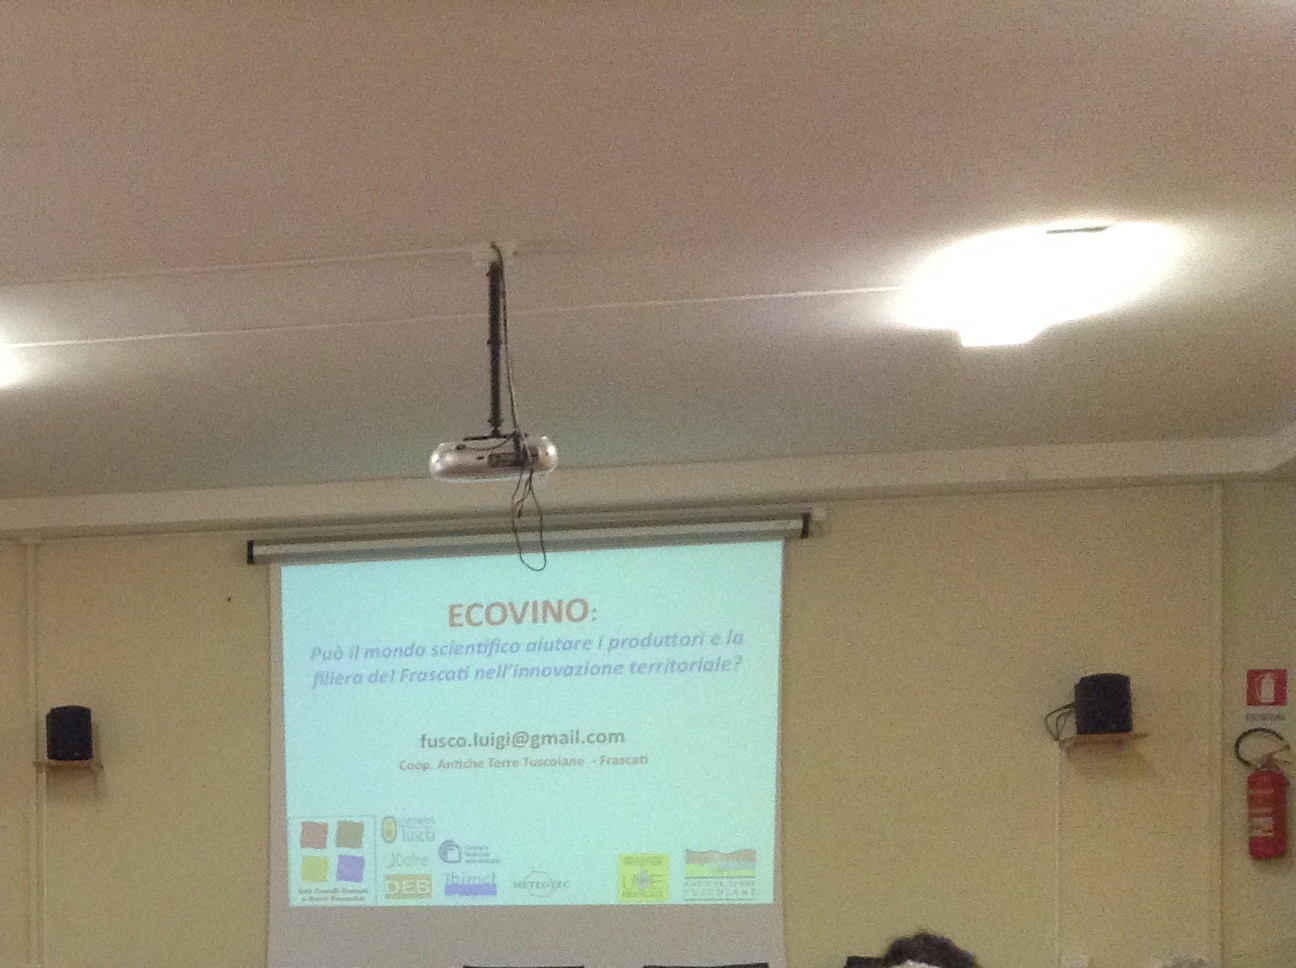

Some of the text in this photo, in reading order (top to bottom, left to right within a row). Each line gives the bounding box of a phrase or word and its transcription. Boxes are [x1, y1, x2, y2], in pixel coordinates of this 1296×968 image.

[448, 597, 597, 629] ECOVINO:
[310, 629, 744, 661] Può il mondo scientifico aiutare i produttori e la
[312, 671, 364, 690] filiera
[368, 669, 395, 685] del
[399, 666, 469, 683] Frascati
[629, 655, 743, 675] territoriale?
[420, 730, 625, 749] fusco.luigi@gmail.com
[437, 758, 484, 769] Antiche
[488, 757, 520, 768] Terre
[523, 756, 584, 768] Tuscolane
[600, 754, 649, 767] Frascati
